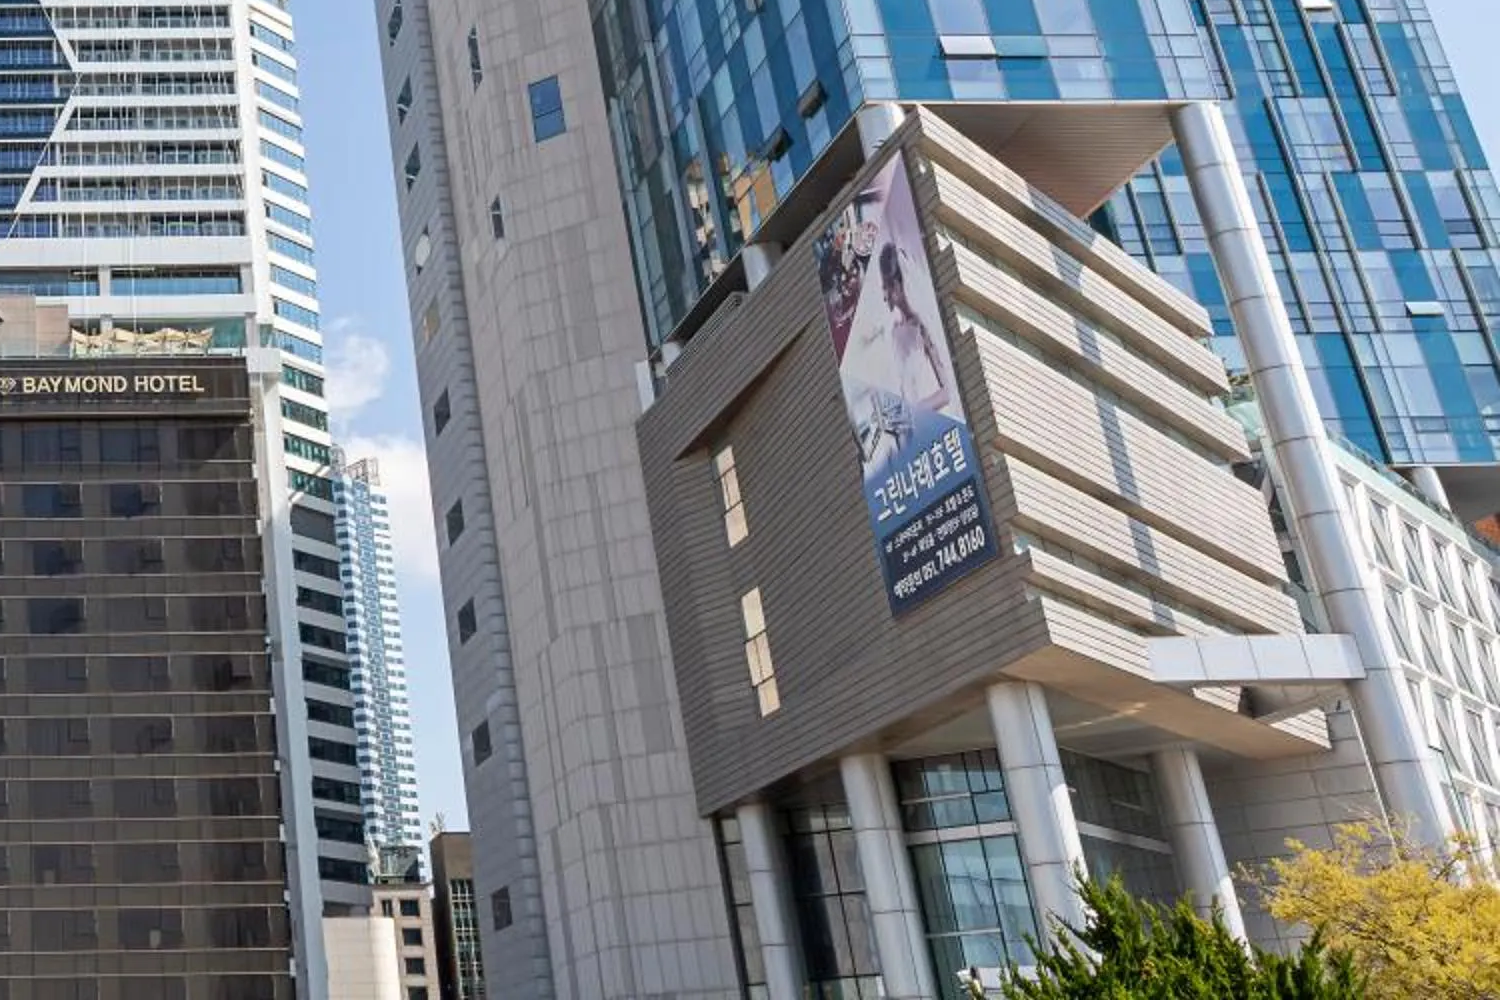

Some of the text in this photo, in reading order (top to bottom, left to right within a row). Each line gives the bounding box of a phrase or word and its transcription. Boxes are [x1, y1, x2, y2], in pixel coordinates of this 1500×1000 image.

[22, 375, 205, 394] BAYMOND HOTEL
[875, 427, 967, 521] 그린나래호텔
